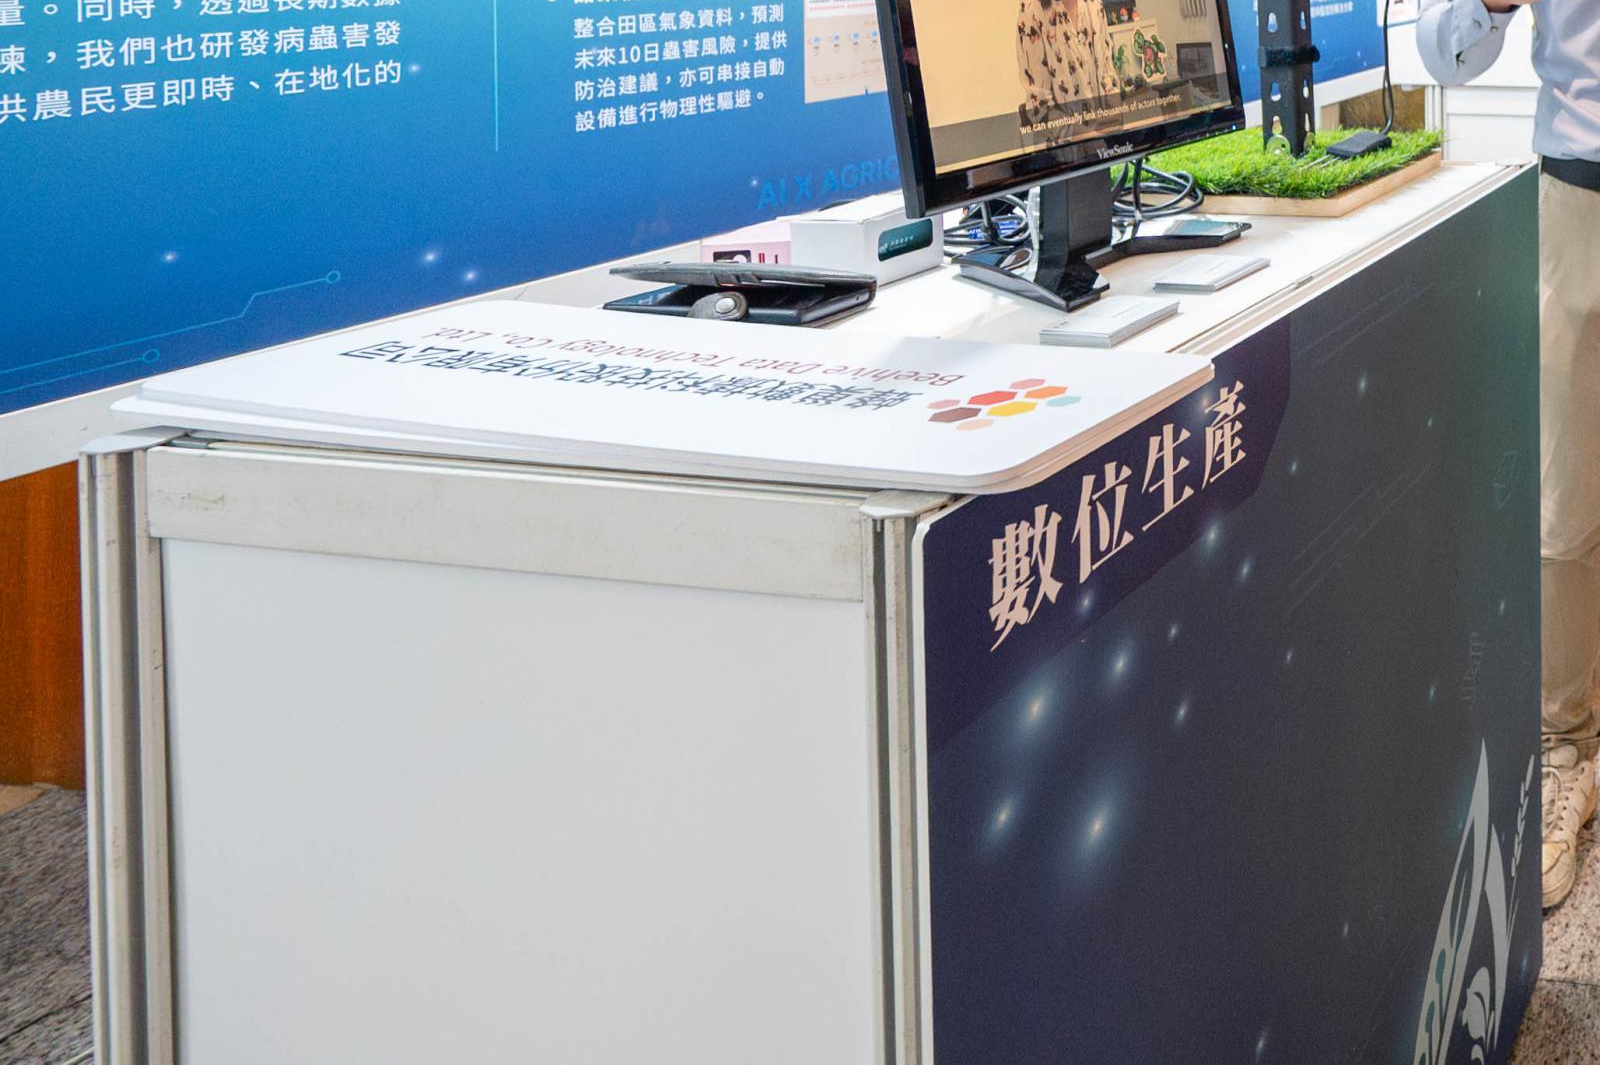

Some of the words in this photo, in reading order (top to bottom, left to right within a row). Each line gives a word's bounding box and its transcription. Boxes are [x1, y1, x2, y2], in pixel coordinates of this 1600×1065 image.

[573, 2, 784, 39] 整合田區氣象資料，預測
[574, 56, 785, 102] 防治建議，亦可串接自動
[575, 88, 765, 133] 設備進行物理性驅避。
[1020, 126, 1033, 135] we
[1033, 122, 1047, 132] can
[1047, 111, 1083, 129] eventually
[1097, 105, 1130, 118] thousands
[1130, 101, 1137, 110] of
[1137, 99, 1156, 109] actors
[1096, 141, 1134, 160] ViewSonic
[757, 179, 787, 211] AI
[502, 332, 553, 350] Co.,
[549, 338, 736, 368] Technology
[338, 340, 923, 410] 蜂巢數據科技股份有限公司
[739, 357, 823, 375] Data
[823, 364, 965, 387] Beehive
[988, 380, 1246, 653] 數位生產
